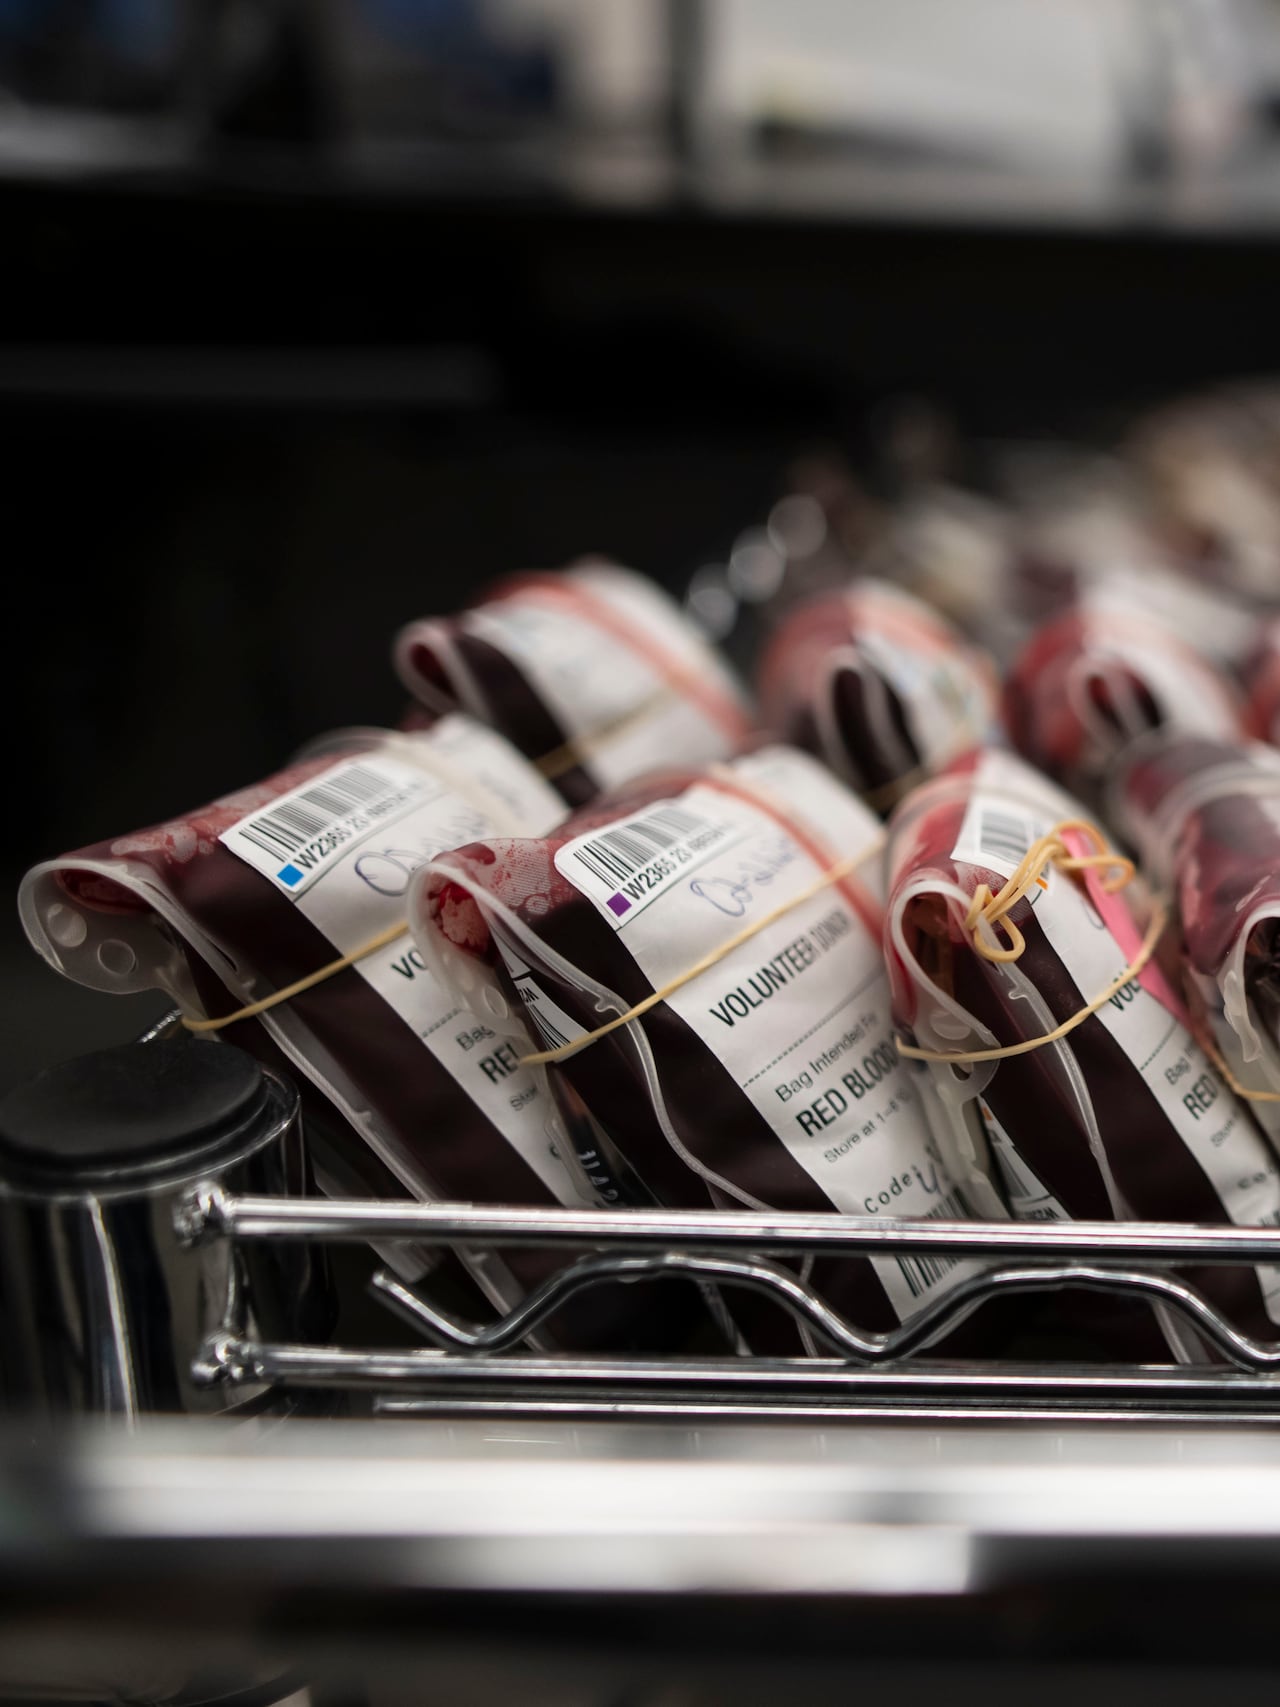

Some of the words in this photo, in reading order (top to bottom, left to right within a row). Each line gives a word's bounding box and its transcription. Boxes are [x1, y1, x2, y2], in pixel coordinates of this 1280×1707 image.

[622, 857, 677, 901] W2365
[709, 937, 820, 1027] VOLUNTEER
[775, 1071, 814, 1103] Bag
[809, 1021, 866, 1075] Intended
[795, 1088, 848, 1138] RED
[824, 1131, 862, 1164] Store
[861, 1119, 877, 1138] at
